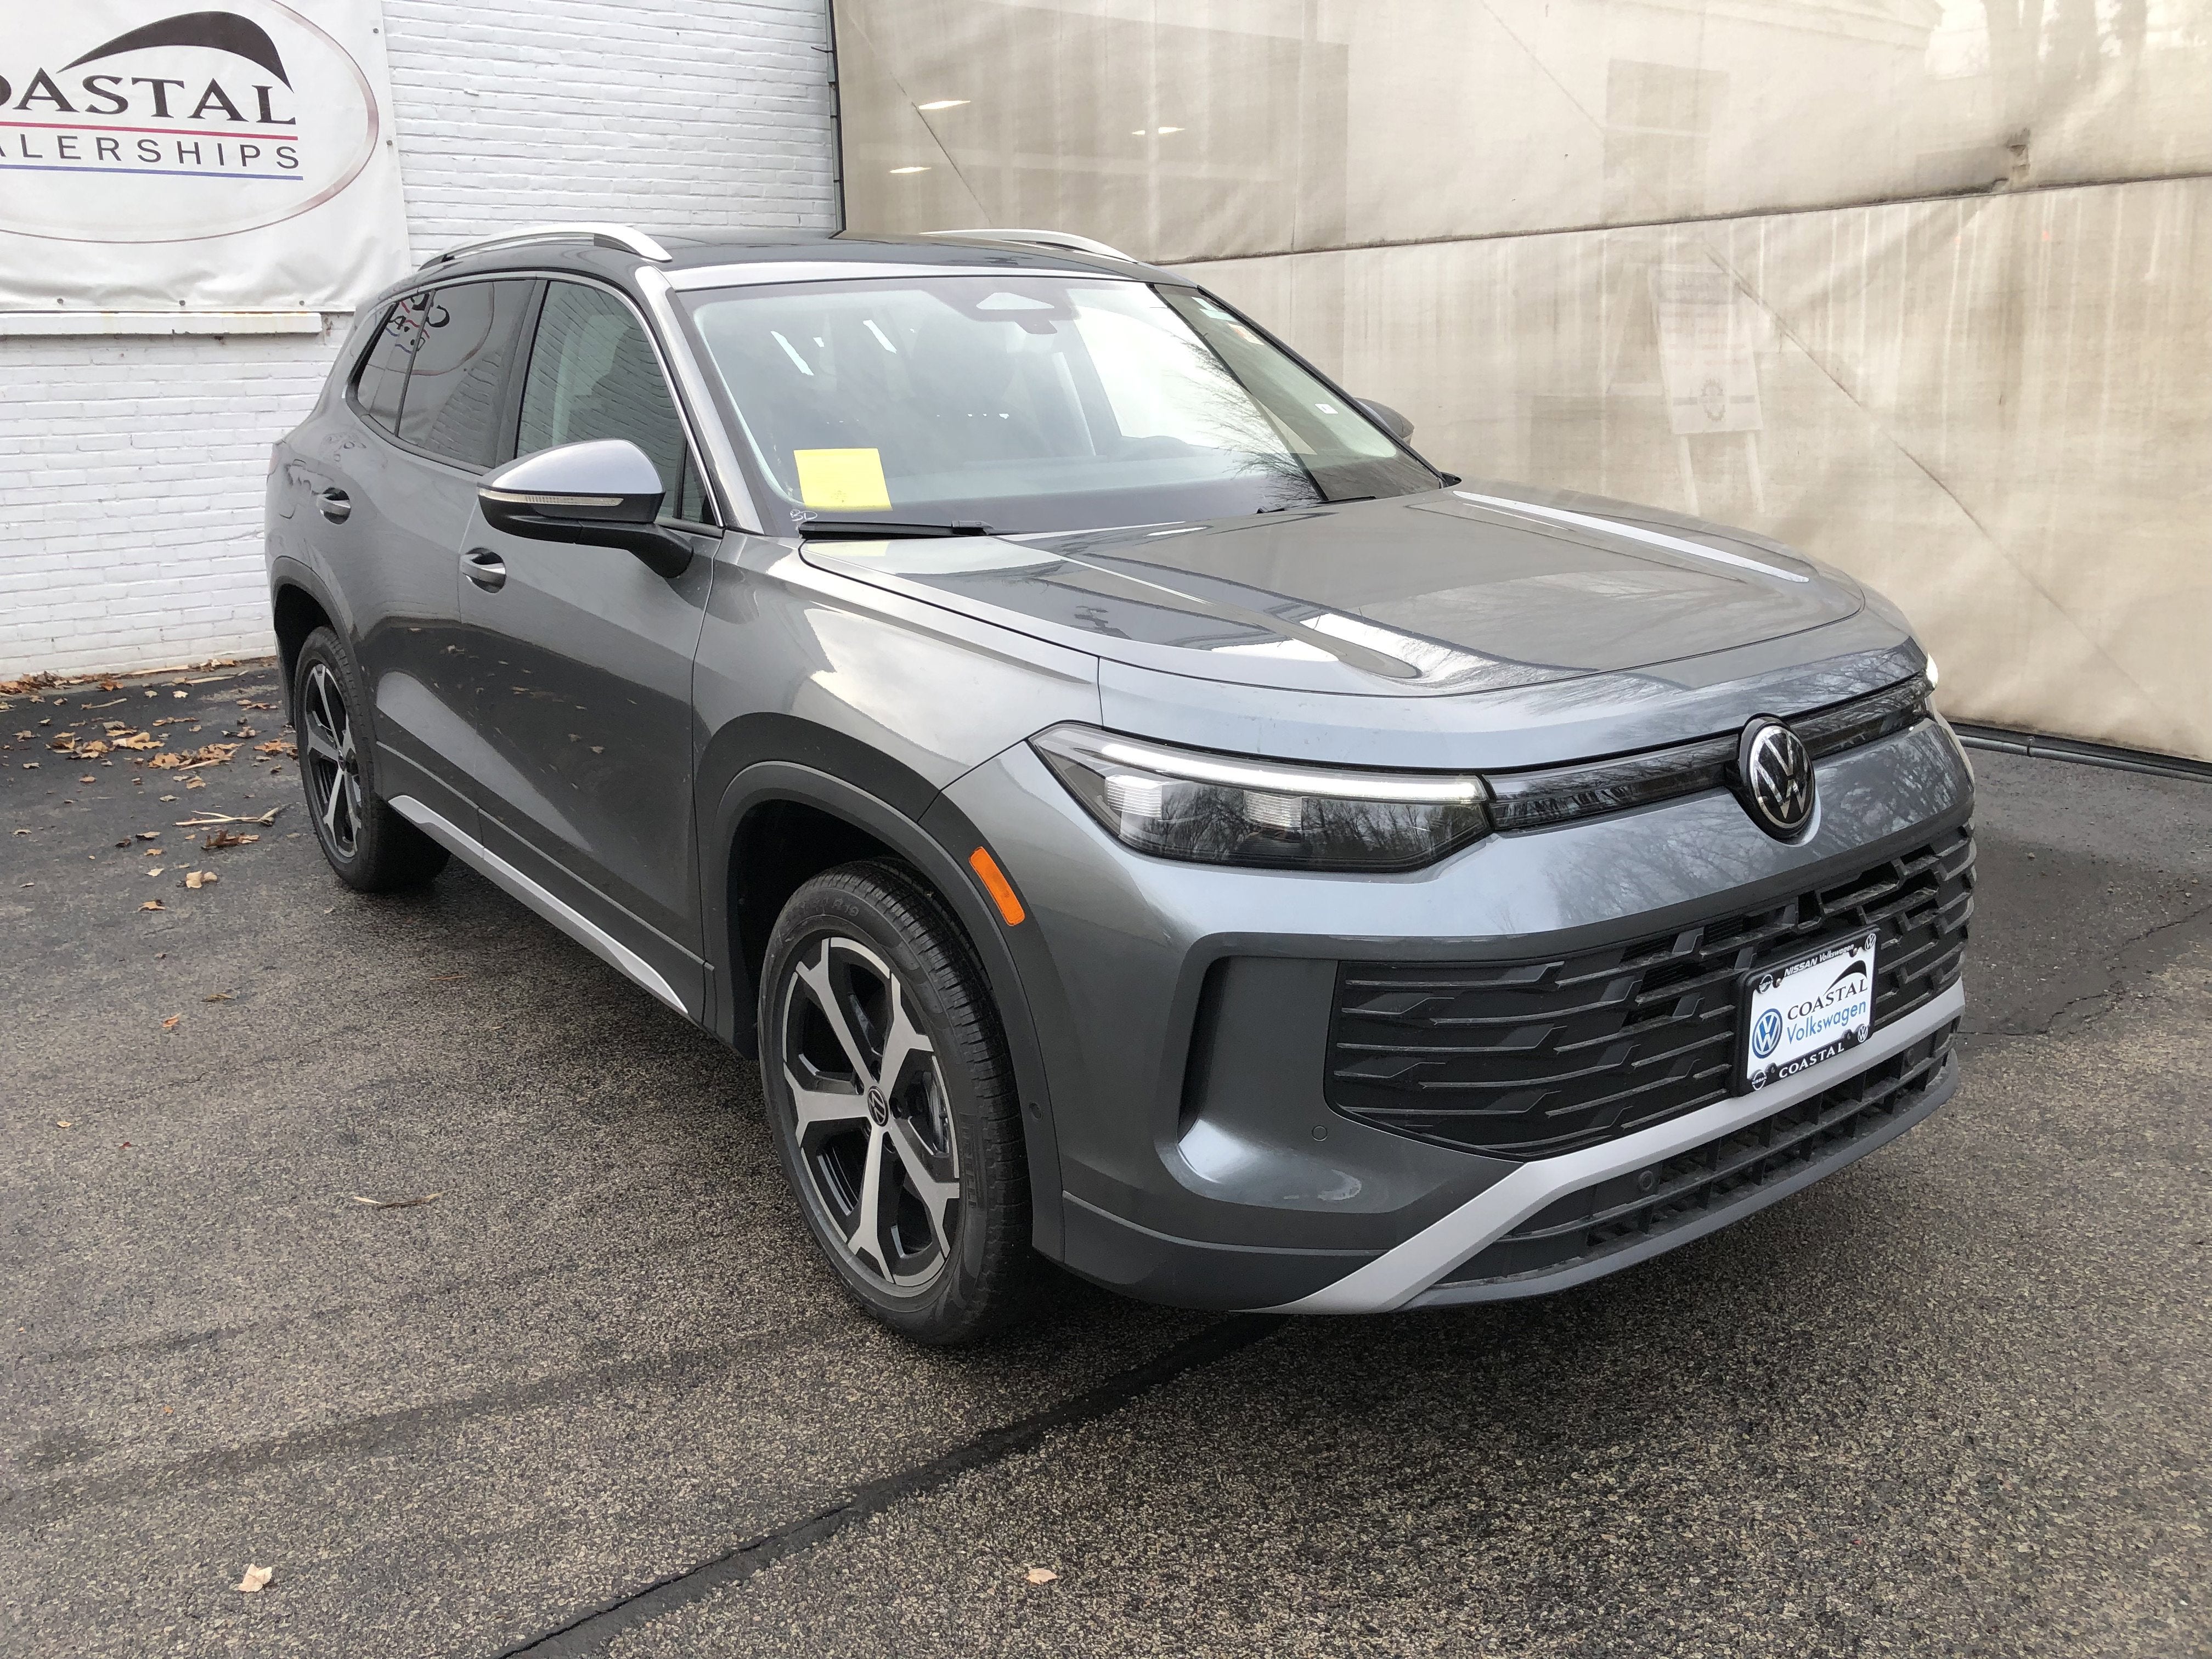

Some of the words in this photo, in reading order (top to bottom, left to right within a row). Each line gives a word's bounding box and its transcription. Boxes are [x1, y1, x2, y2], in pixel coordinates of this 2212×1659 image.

[0, 134, 299, 169] LERSHIPS
[1784, 957, 1818, 977] NISSAN
[1819, 944, 1854, 962] Volkswagen
[1787, 979, 1867, 1020] COASTAL
[1787, 1001, 1866, 1045] Volkswagen
[1779, 1042, 1845, 1078] COASTAL
